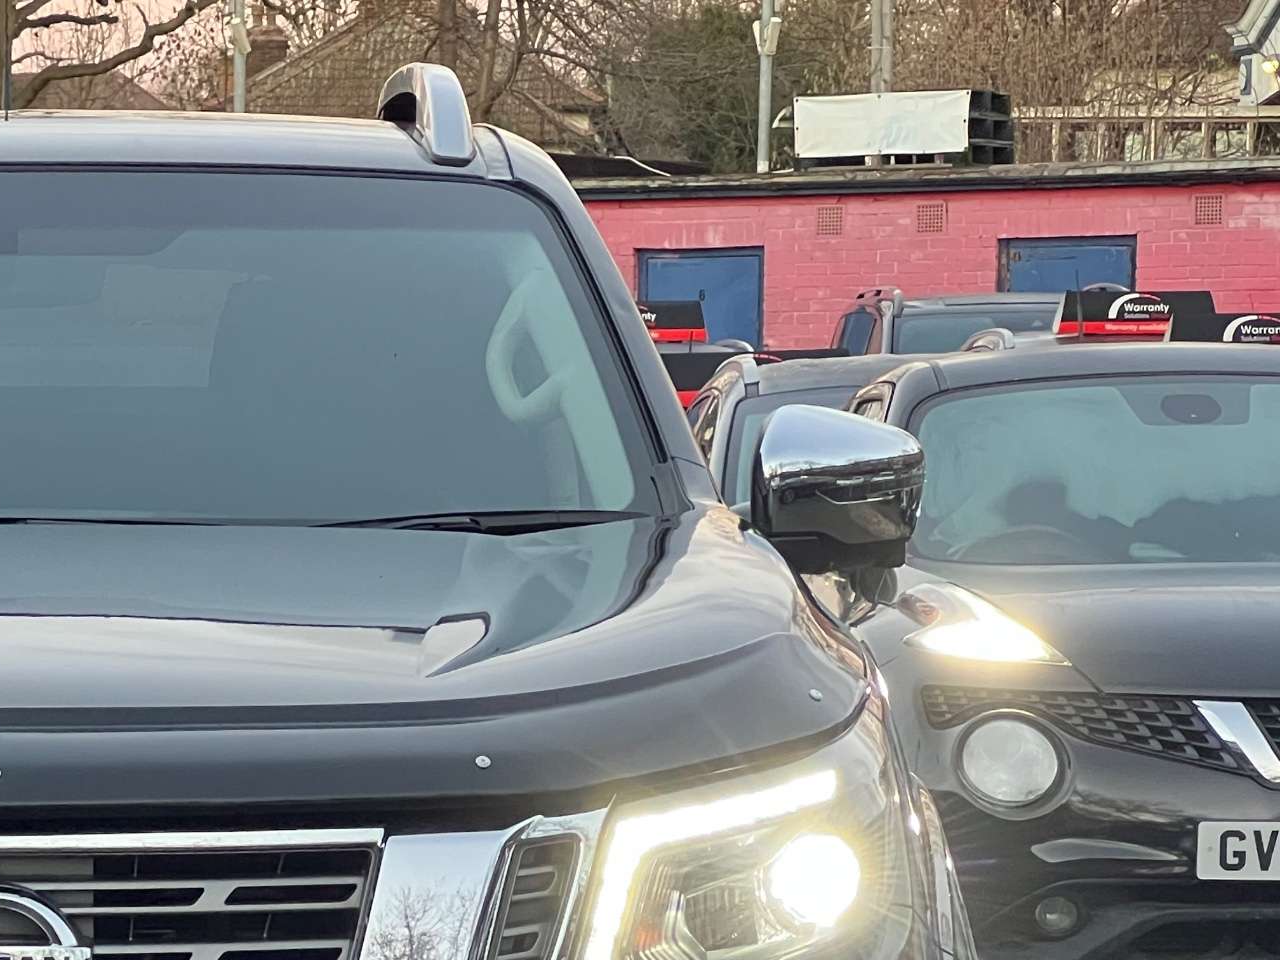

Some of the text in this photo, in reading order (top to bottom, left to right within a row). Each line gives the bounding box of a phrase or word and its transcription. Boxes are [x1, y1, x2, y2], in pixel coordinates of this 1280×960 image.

[1123, 303, 1170, 314] Warranty
[1240, 325, 1280, 335] Warran
[1219, 829, 1280, 872] GV
